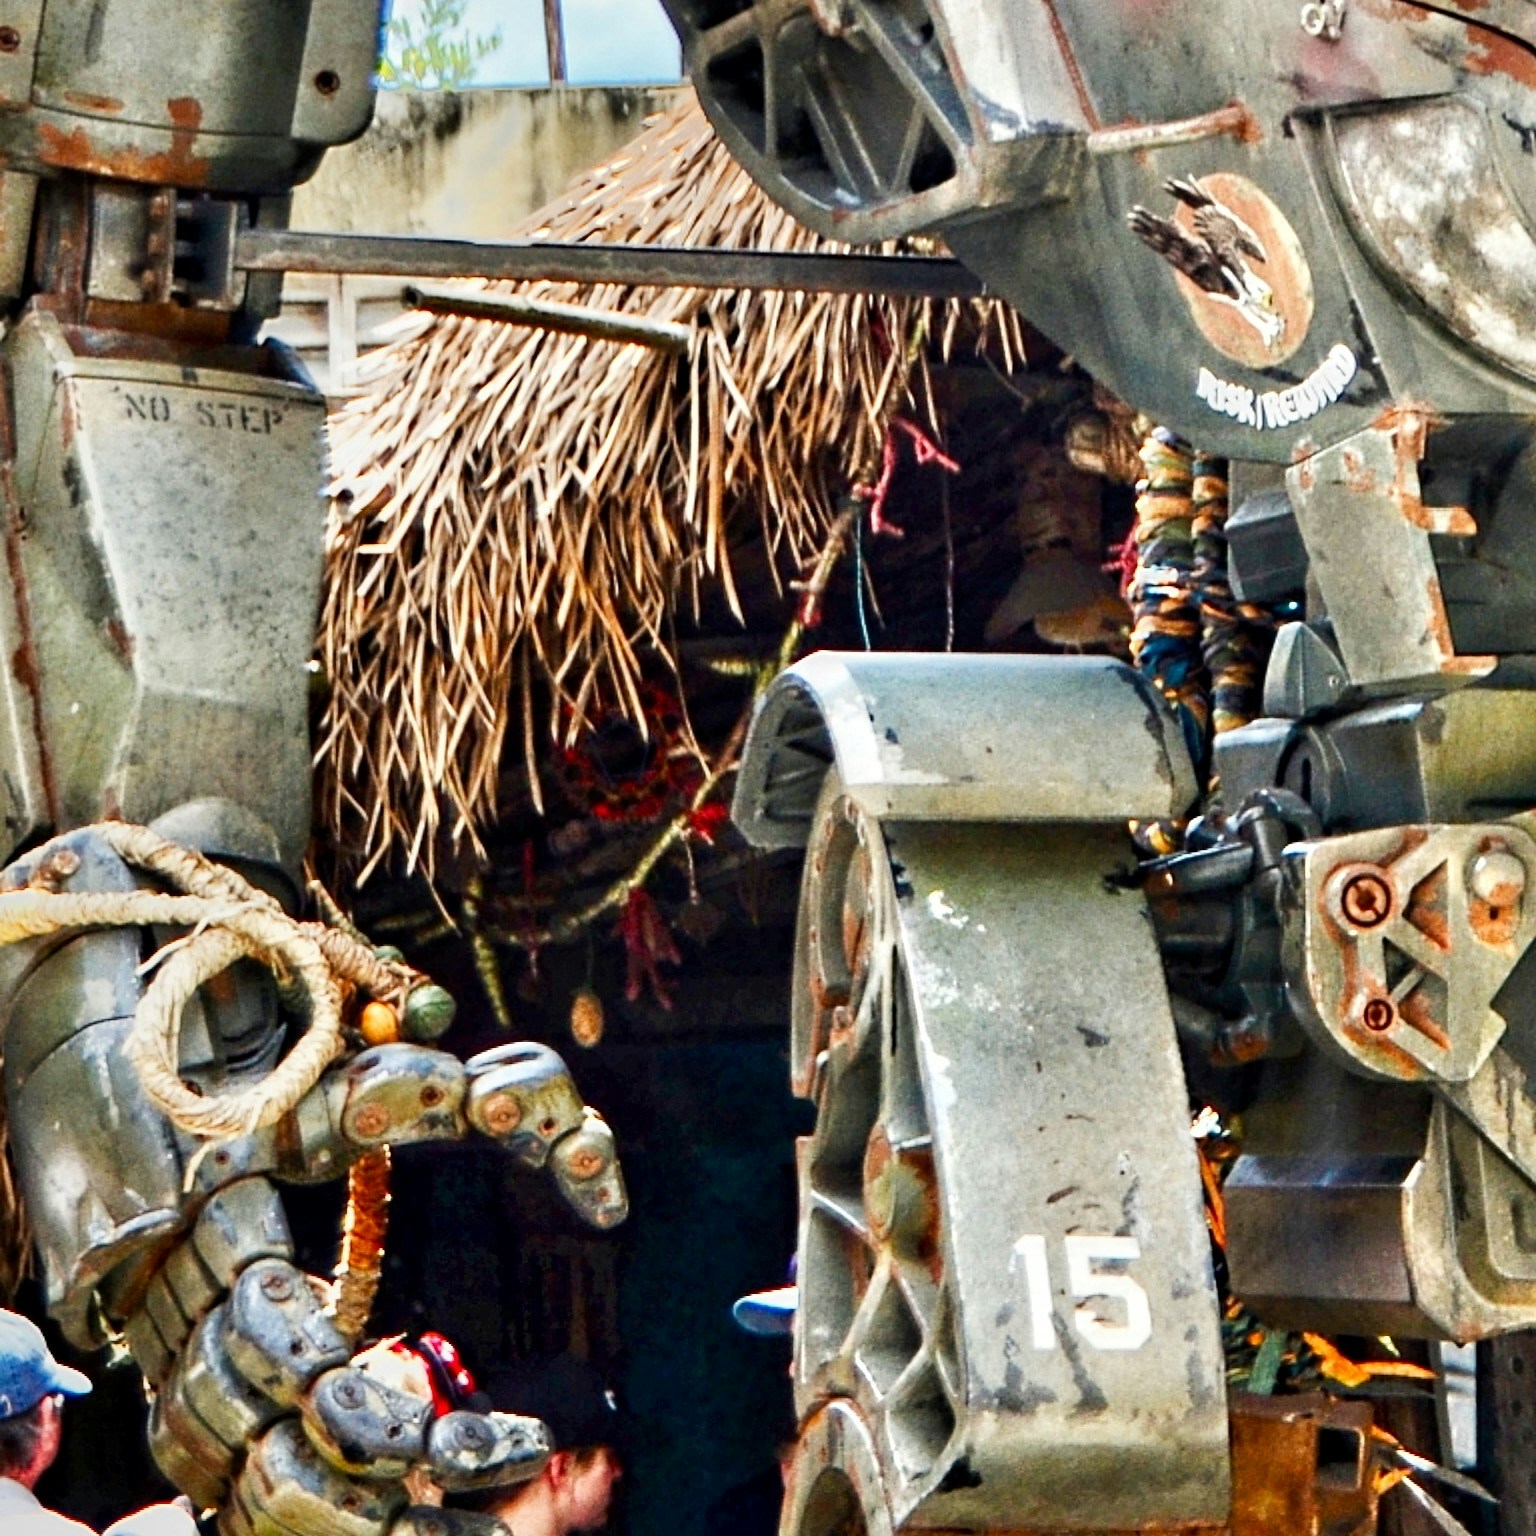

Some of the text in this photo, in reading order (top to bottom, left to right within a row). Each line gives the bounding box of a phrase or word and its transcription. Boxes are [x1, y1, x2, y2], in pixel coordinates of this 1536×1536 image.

[124, 393, 284, 434] NO STEP
[1008, 1233, 1152, 1351] 15
